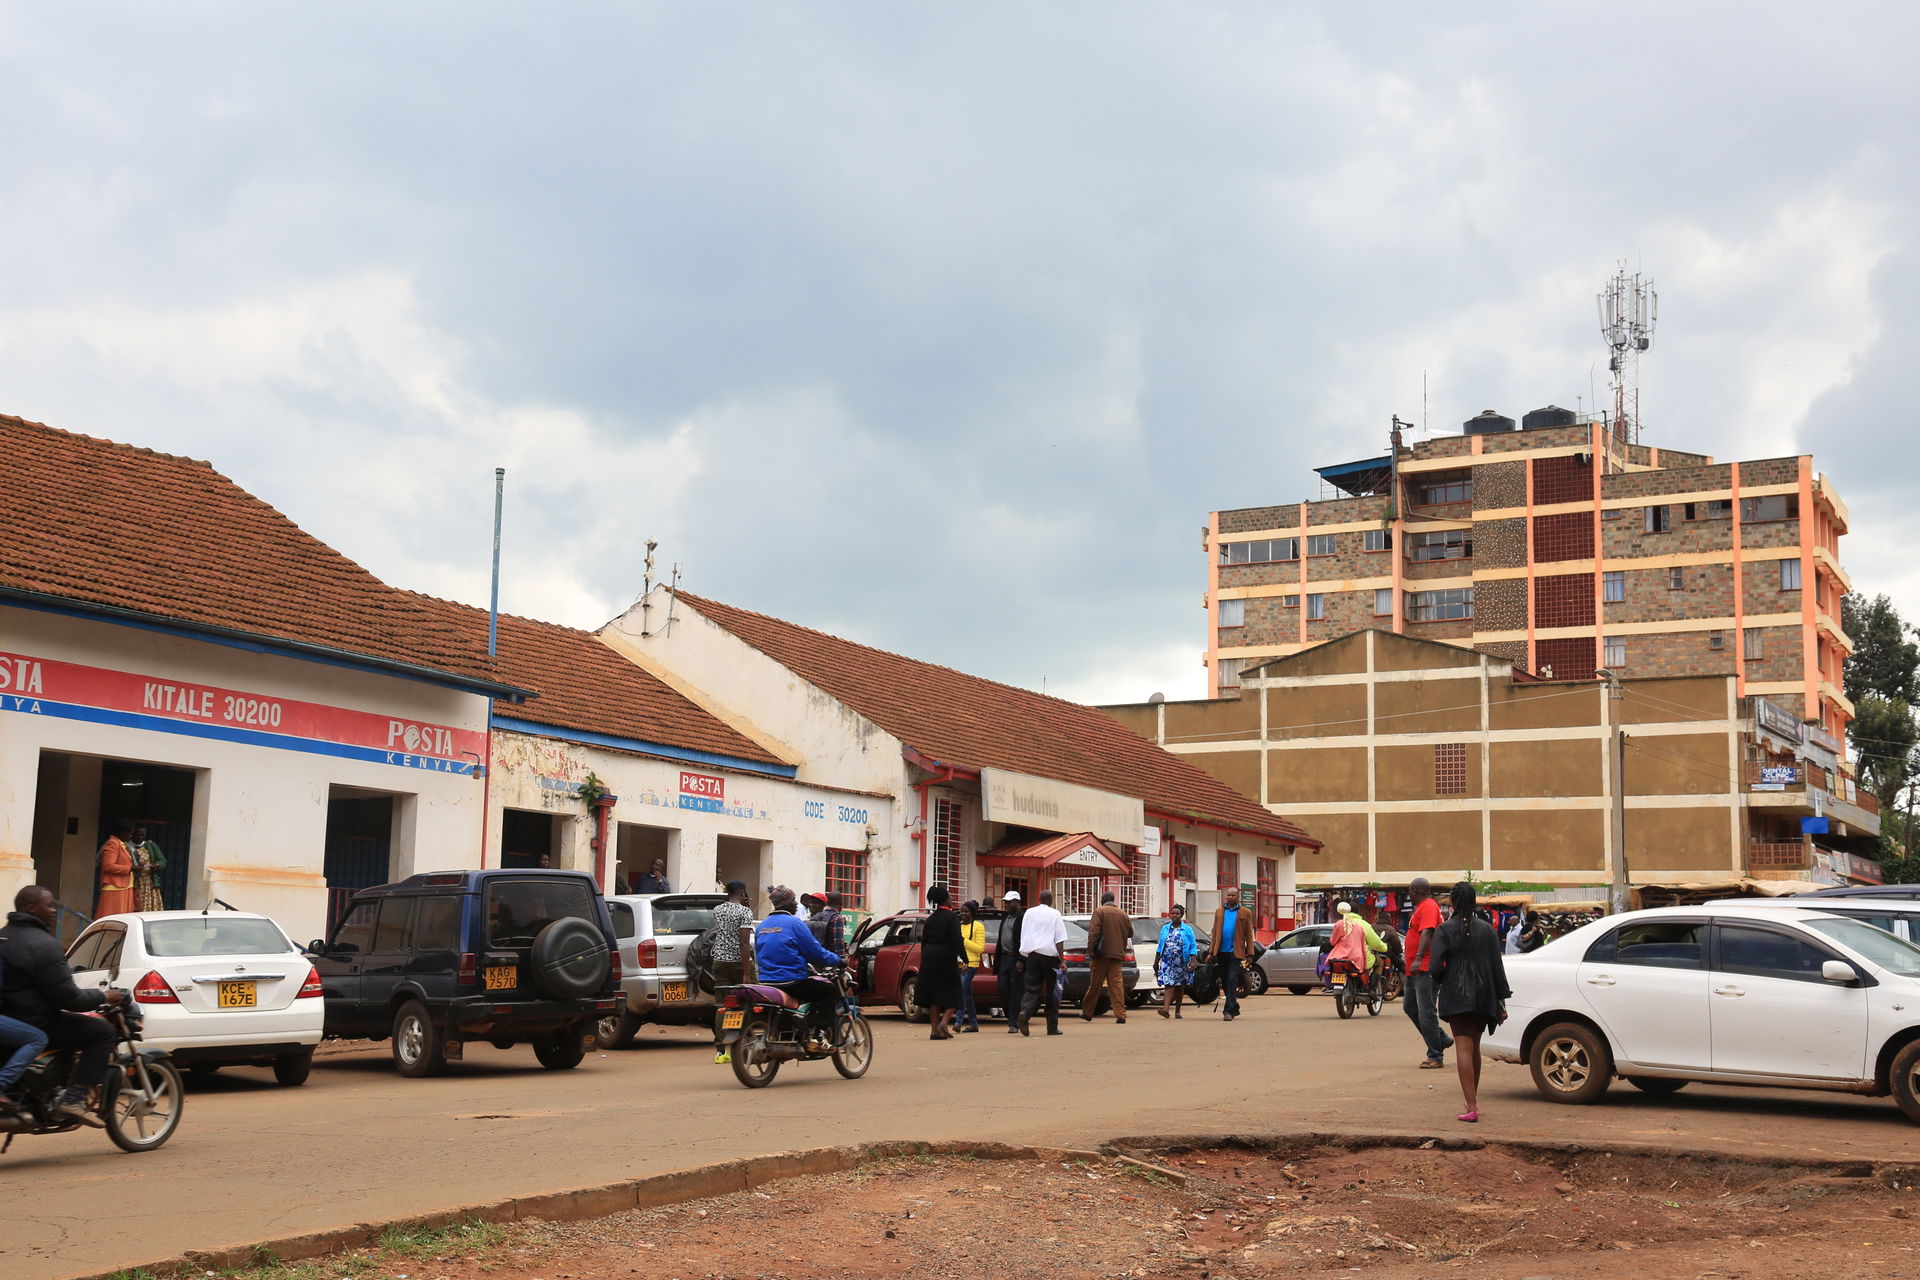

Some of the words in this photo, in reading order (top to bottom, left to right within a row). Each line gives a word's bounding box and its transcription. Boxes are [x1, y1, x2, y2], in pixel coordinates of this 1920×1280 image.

[144, 682, 215, 718] KITALE
[223, 696, 282, 727] 30200
[387, 720, 453, 756] POSTA
[386, 752, 452, 772] KENYA
[1762, 766, 1793, 774] DENTAL
[682, 775, 721, 795] POSTA
[804, 800, 825, 819] CODE
[838, 805, 868, 825] 30200
[1012, 789, 1060, 818] huduma
[1079, 849, 1099, 863] ENTRY
[489, 967, 511, 979] KAG
[222, 983, 246, 995] KCE
[223, 993, 253, 1006] 167E
